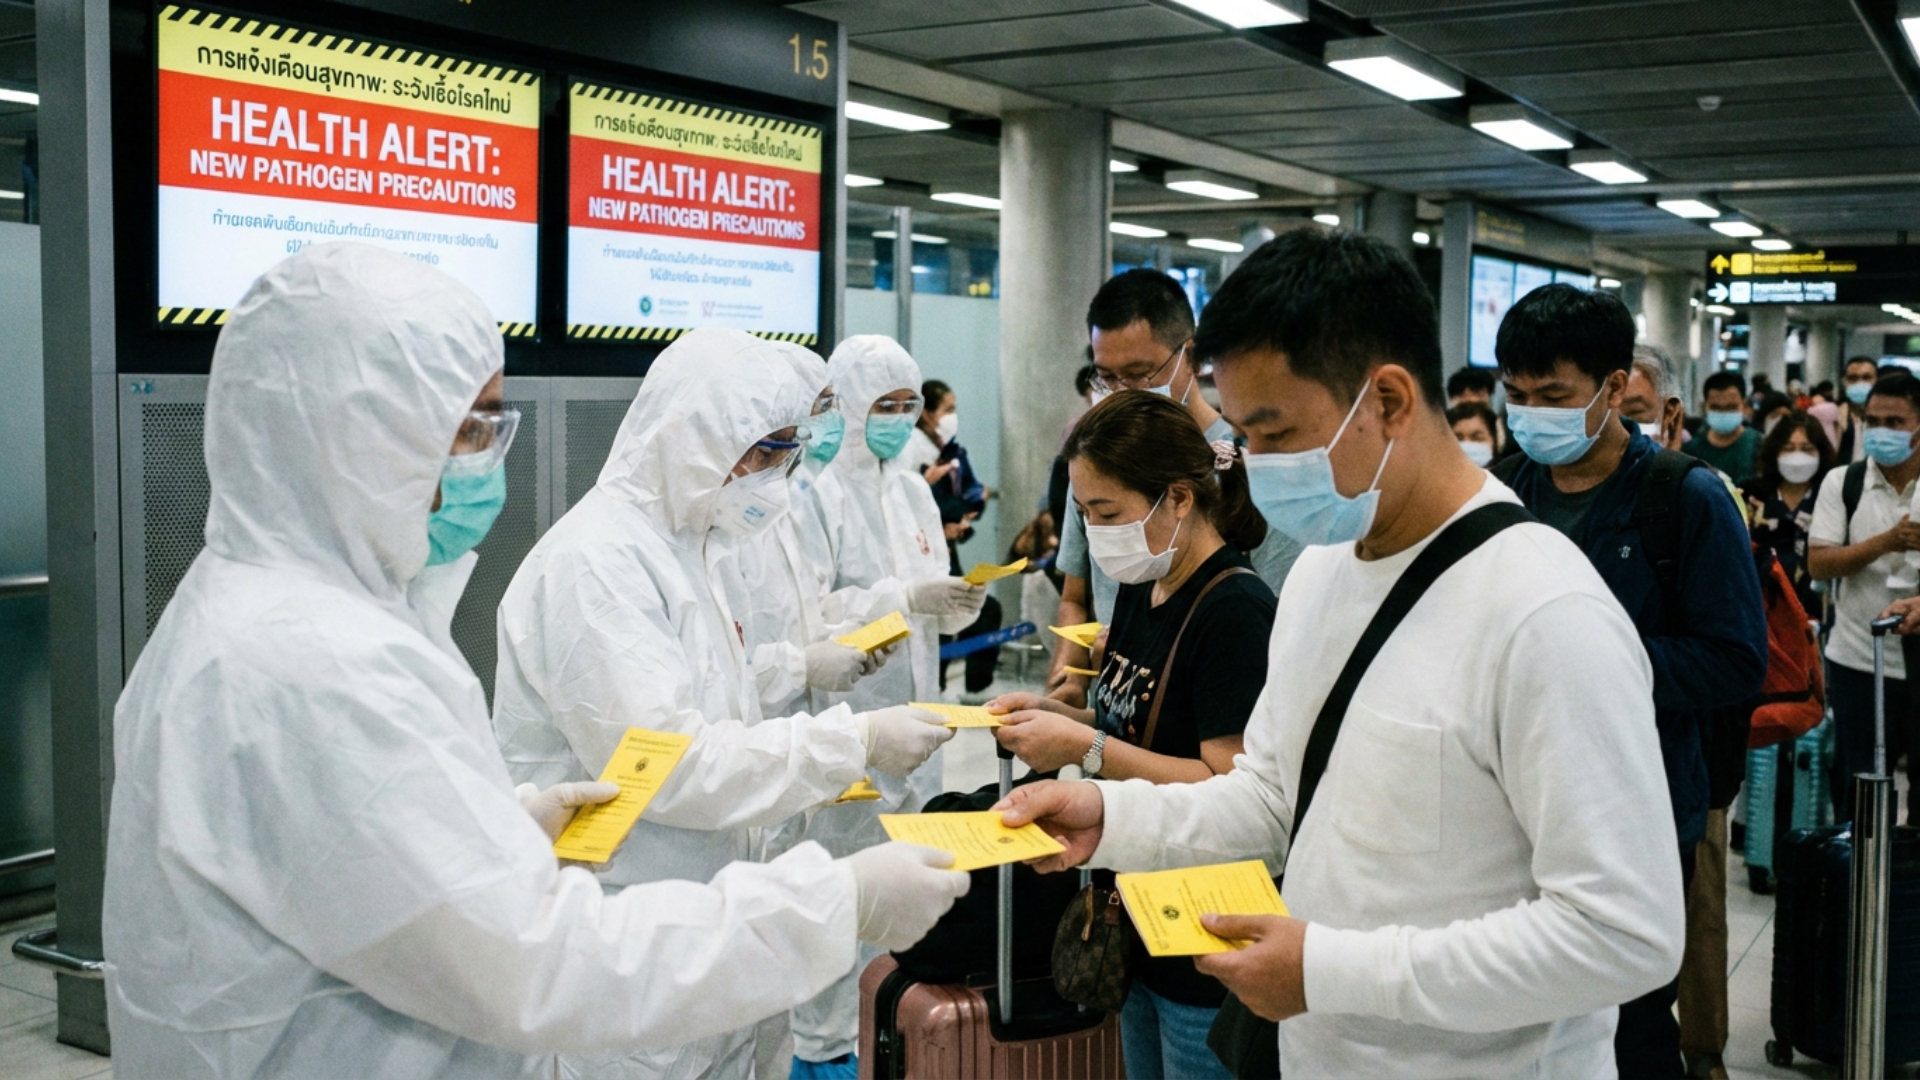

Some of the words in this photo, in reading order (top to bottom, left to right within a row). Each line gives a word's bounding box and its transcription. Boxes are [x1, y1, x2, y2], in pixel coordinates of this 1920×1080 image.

[788, 33, 829, 80] 1.5
[212, 97, 367, 159] HEALTH
[378, 123, 500, 176] ALERT:
[190, 149, 247, 180] NEW
[253, 156, 373, 194] PATHOGEN
[378, 172, 517, 210] PRECAUTIONS
[602, 154, 706, 202] HEALTH
[711, 171, 796, 213] ALERT:
[588, 196, 626, 221] NEW
[629, 201, 709, 230] PATHOGEN
[712, 211, 806, 241] PRECAUTIONS
